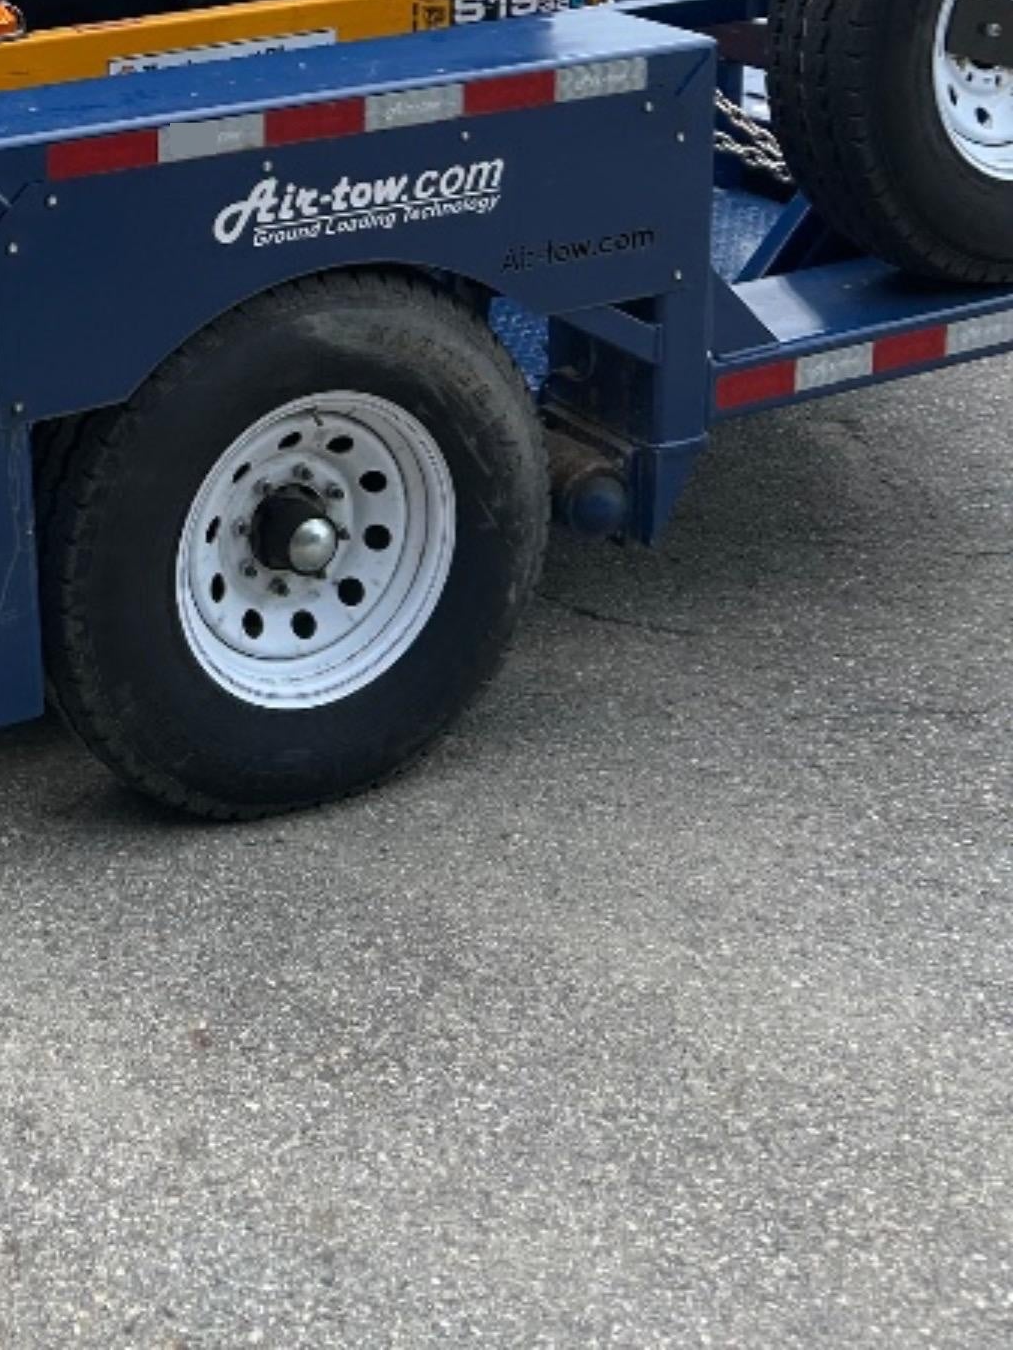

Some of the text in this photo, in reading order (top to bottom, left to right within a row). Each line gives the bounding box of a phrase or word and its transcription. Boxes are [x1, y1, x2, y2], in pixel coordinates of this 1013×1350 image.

[213, 158, 504, 244] Air-tow.com
[253, 195, 501, 247] Ground Loading Technology
